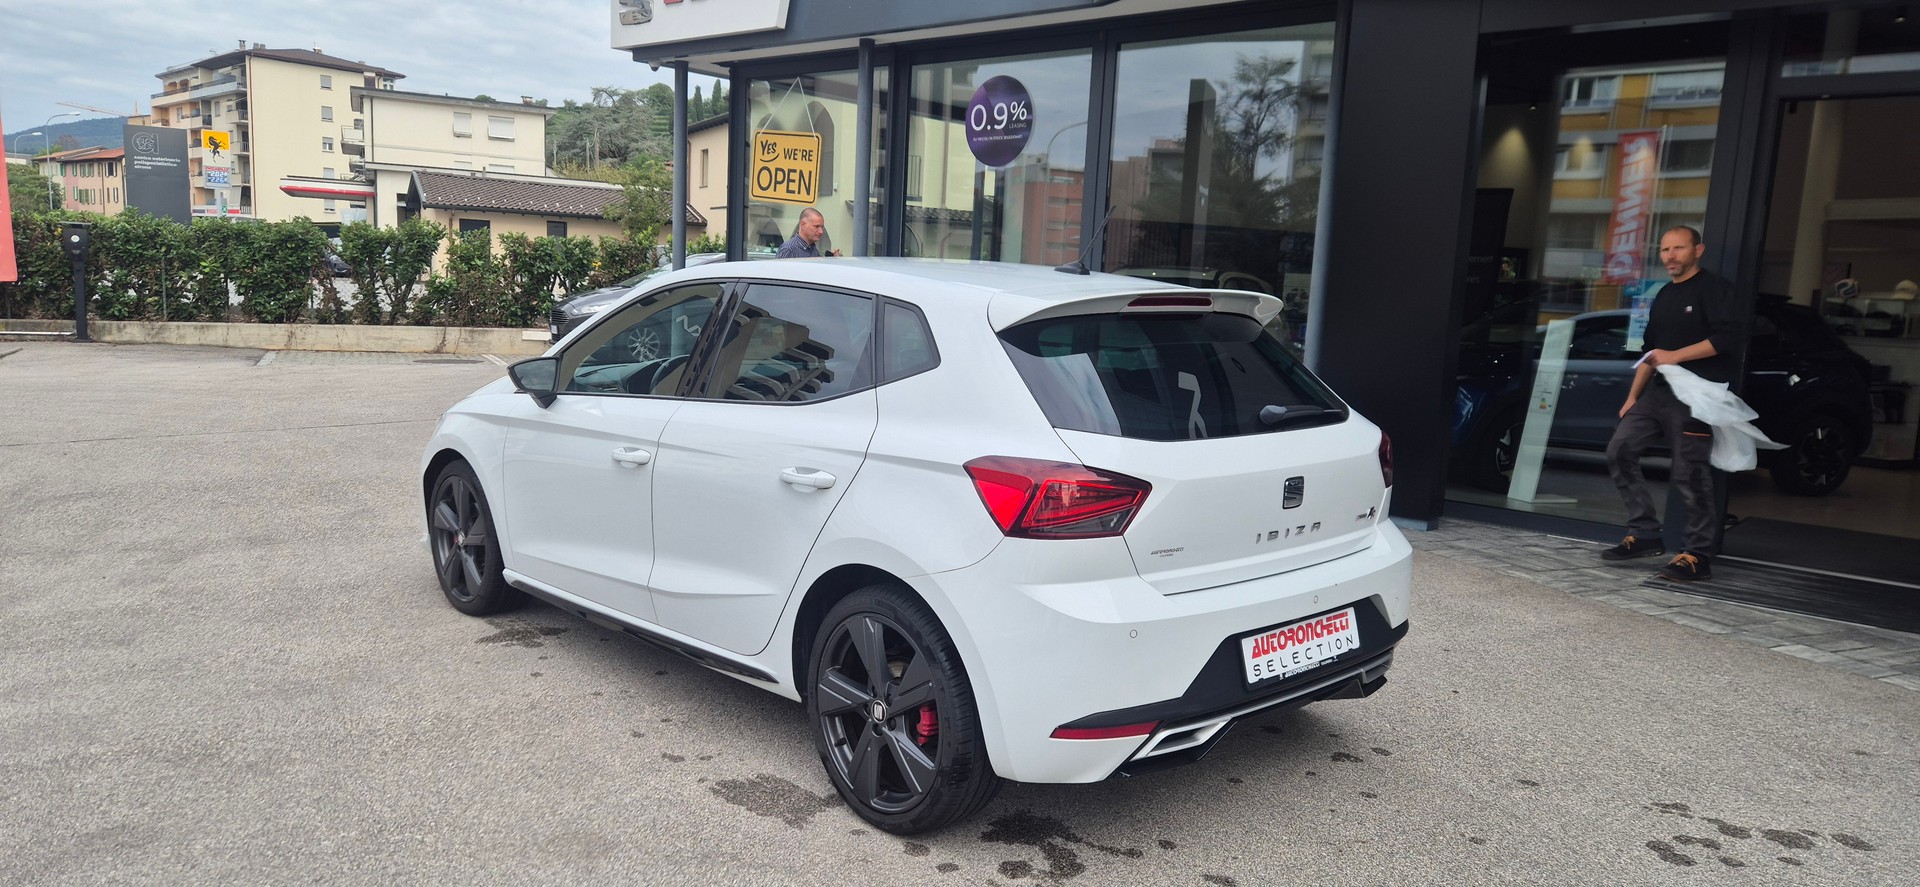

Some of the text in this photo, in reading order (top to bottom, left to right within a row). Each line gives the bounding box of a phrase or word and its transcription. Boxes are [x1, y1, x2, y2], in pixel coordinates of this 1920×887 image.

[970, 100, 1027, 131] 0.9%
[760, 139, 777, 156] YES
[783, 148, 814, 162] WE'RE
[756, 165, 813, 196] OPEN
[1255, 521, 1322, 544] IBIZA
[1251, 611, 1349, 659] AUTORONCHETTI
[1253, 634, 1354, 677] SELECTION
